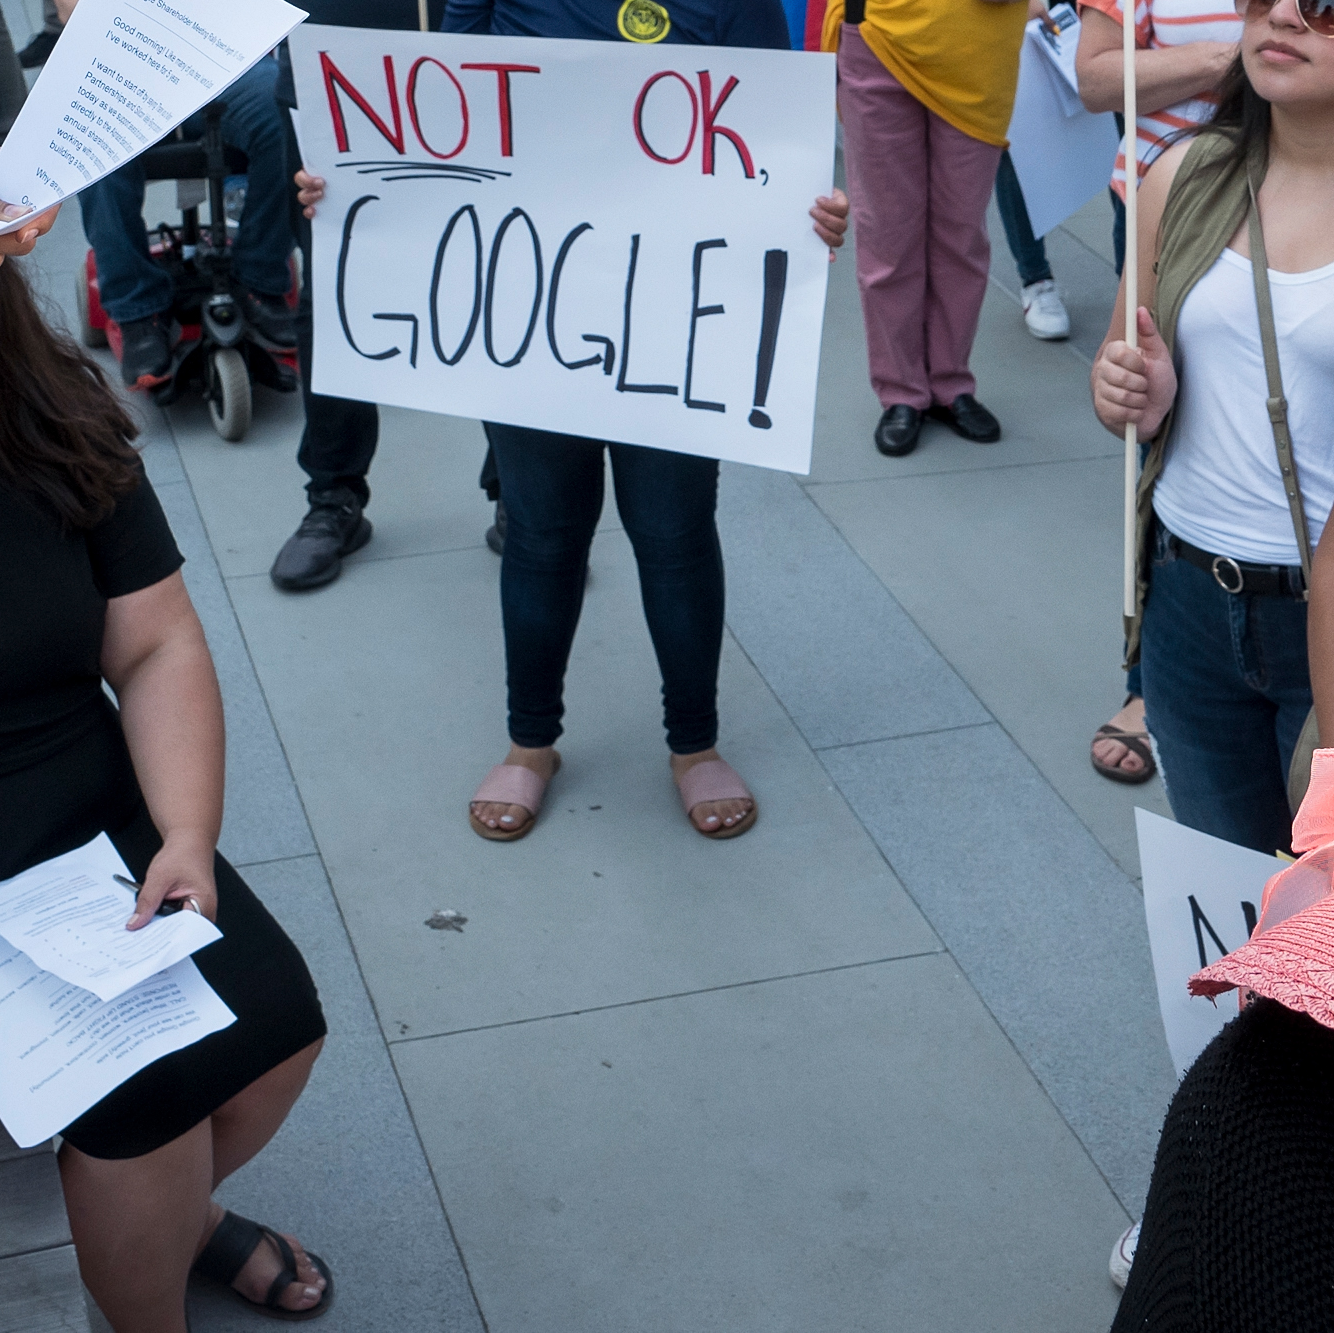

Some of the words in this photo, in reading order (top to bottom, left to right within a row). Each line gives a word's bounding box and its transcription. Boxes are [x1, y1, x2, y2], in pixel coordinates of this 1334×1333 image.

[157, 0, 192, 27] Shareholder
[193, 22, 209, 39] Meeting
[106, 30, 120, 44] I've
[121, 41, 147, 61] worked
[147, 56, 162, 70] here
[160, 64, 168, 75] for
[114, 17, 136, 35] Good
[136, 31, 166, 55] morning!
[166, 49, 177, 62] Like
[85, 71, 126, 105] Partnerships
[126, 100, 135, 111] and
[91, 58, 97, 66] I
[97, 62, 116, 78] want
[116, 72, 124, 83] to
[124, 78, 138, 94] start
[70, 100, 95, 122] directly
[96, 117, 105, 127] to
[78, 86, 99, 105] today
[99, 100, 108, 110] as
[108, 106, 117, 116] we
[319, 51, 540, 159] NOT
[634, 69, 769, 187] OK,
[56, 128, 83, 150] working
[64, 114, 88, 133] annual
[49, 140, 74, 165] building
[36, 167, 51, 185] Why
[336, 195, 788, 429] GOOGLE!
